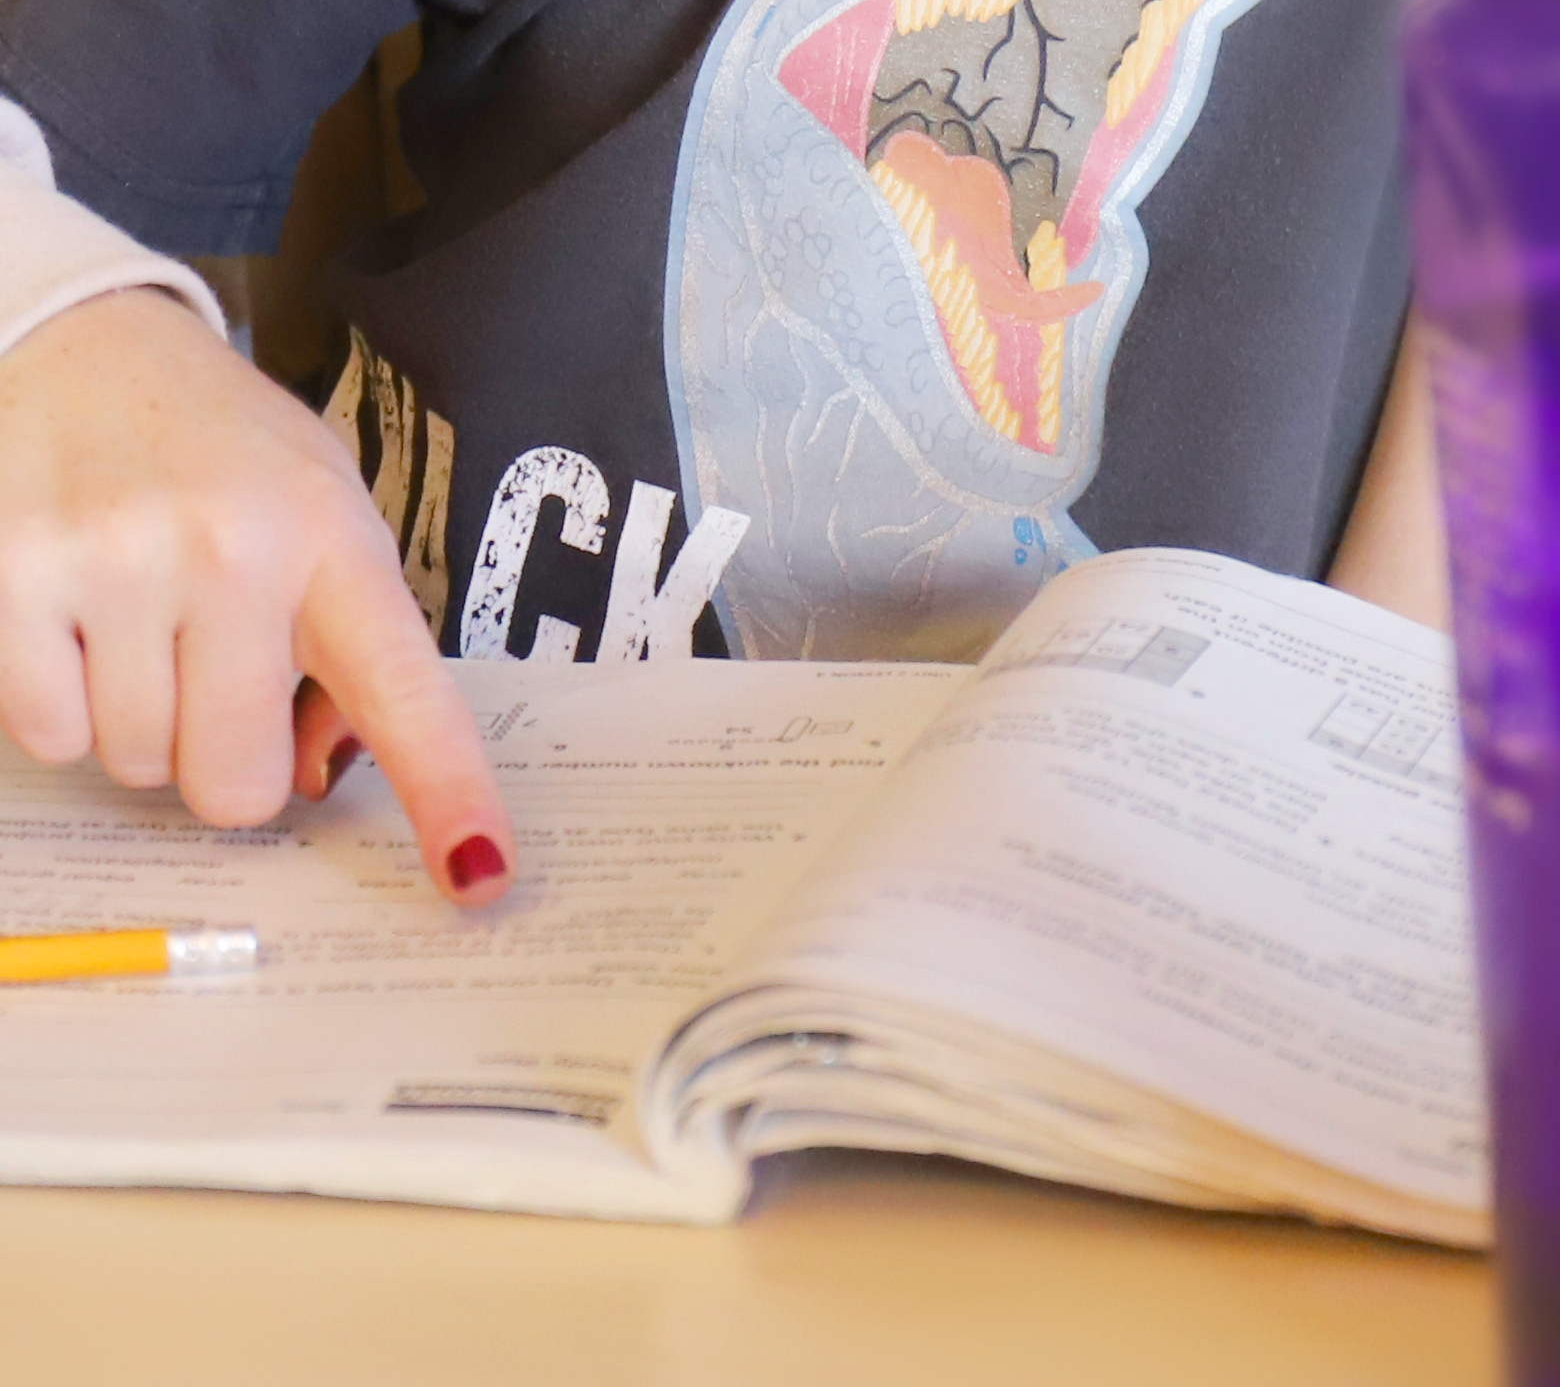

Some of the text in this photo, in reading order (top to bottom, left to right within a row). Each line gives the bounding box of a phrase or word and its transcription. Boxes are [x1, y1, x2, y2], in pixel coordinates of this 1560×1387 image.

[536, 759, 639, 771] number
[647, 757, 770, 770] unknown
[780, 756, 820, 769] the
[829, 756, 885, 769] Find
